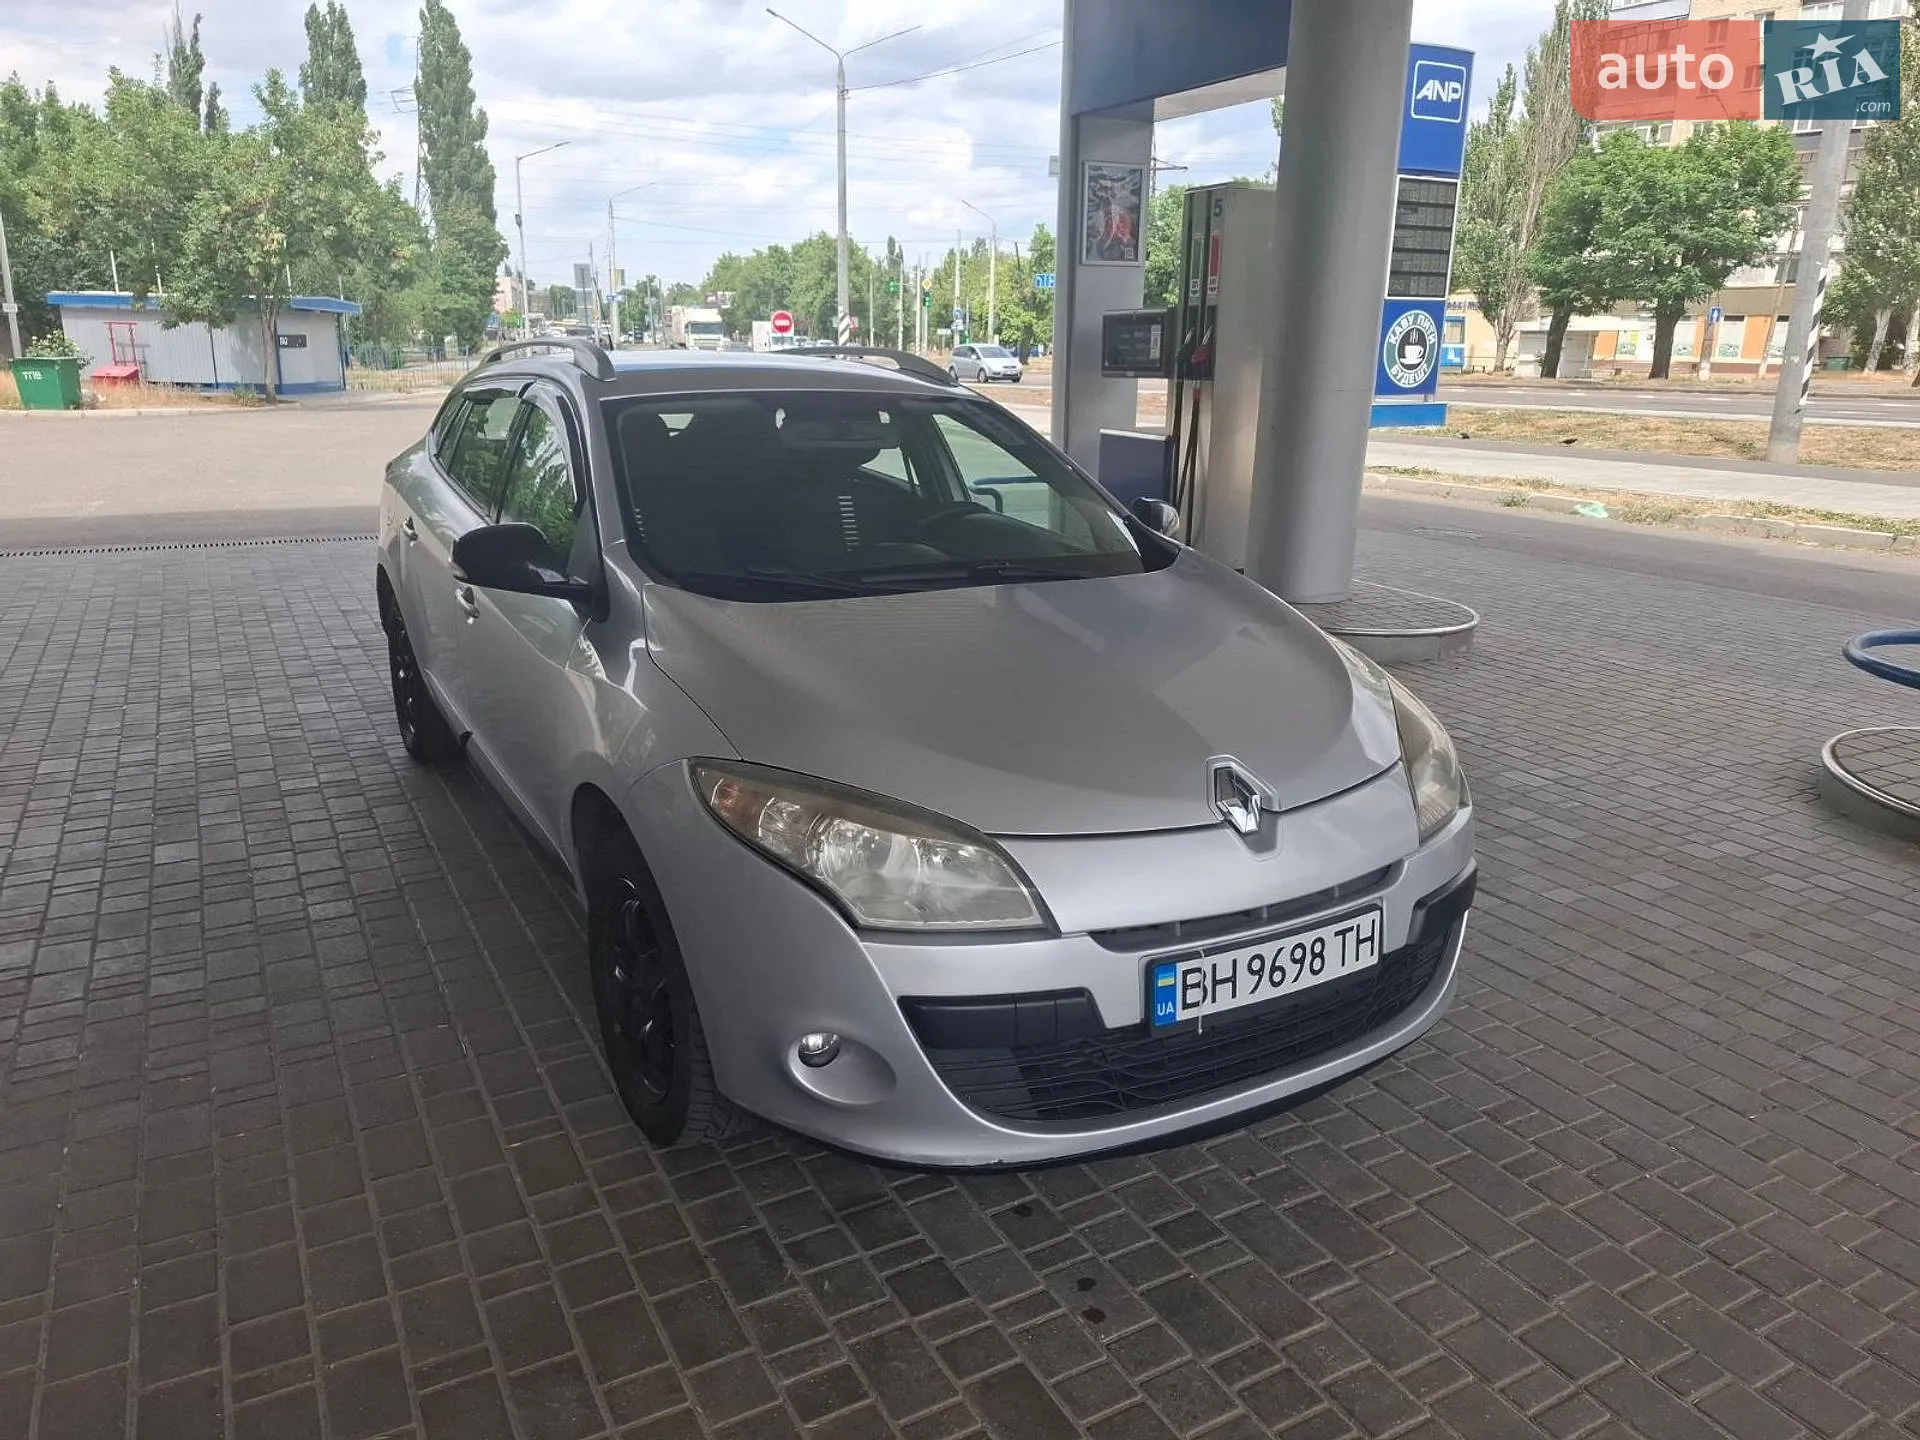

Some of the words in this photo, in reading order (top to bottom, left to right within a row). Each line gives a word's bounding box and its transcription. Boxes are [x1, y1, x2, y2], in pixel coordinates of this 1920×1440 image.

[1416, 79, 1462, 103] ANP
[1213, 198, 1223, 217] 5
[1388, 314, 1415, 345] КАВУ
[1181, 958, 1238, 1011] BH
[1246, 936, 1326, 995] 9698
[1334, 918, 1376, 967] TH
[1157, 1001, 1175, 1016] UA
